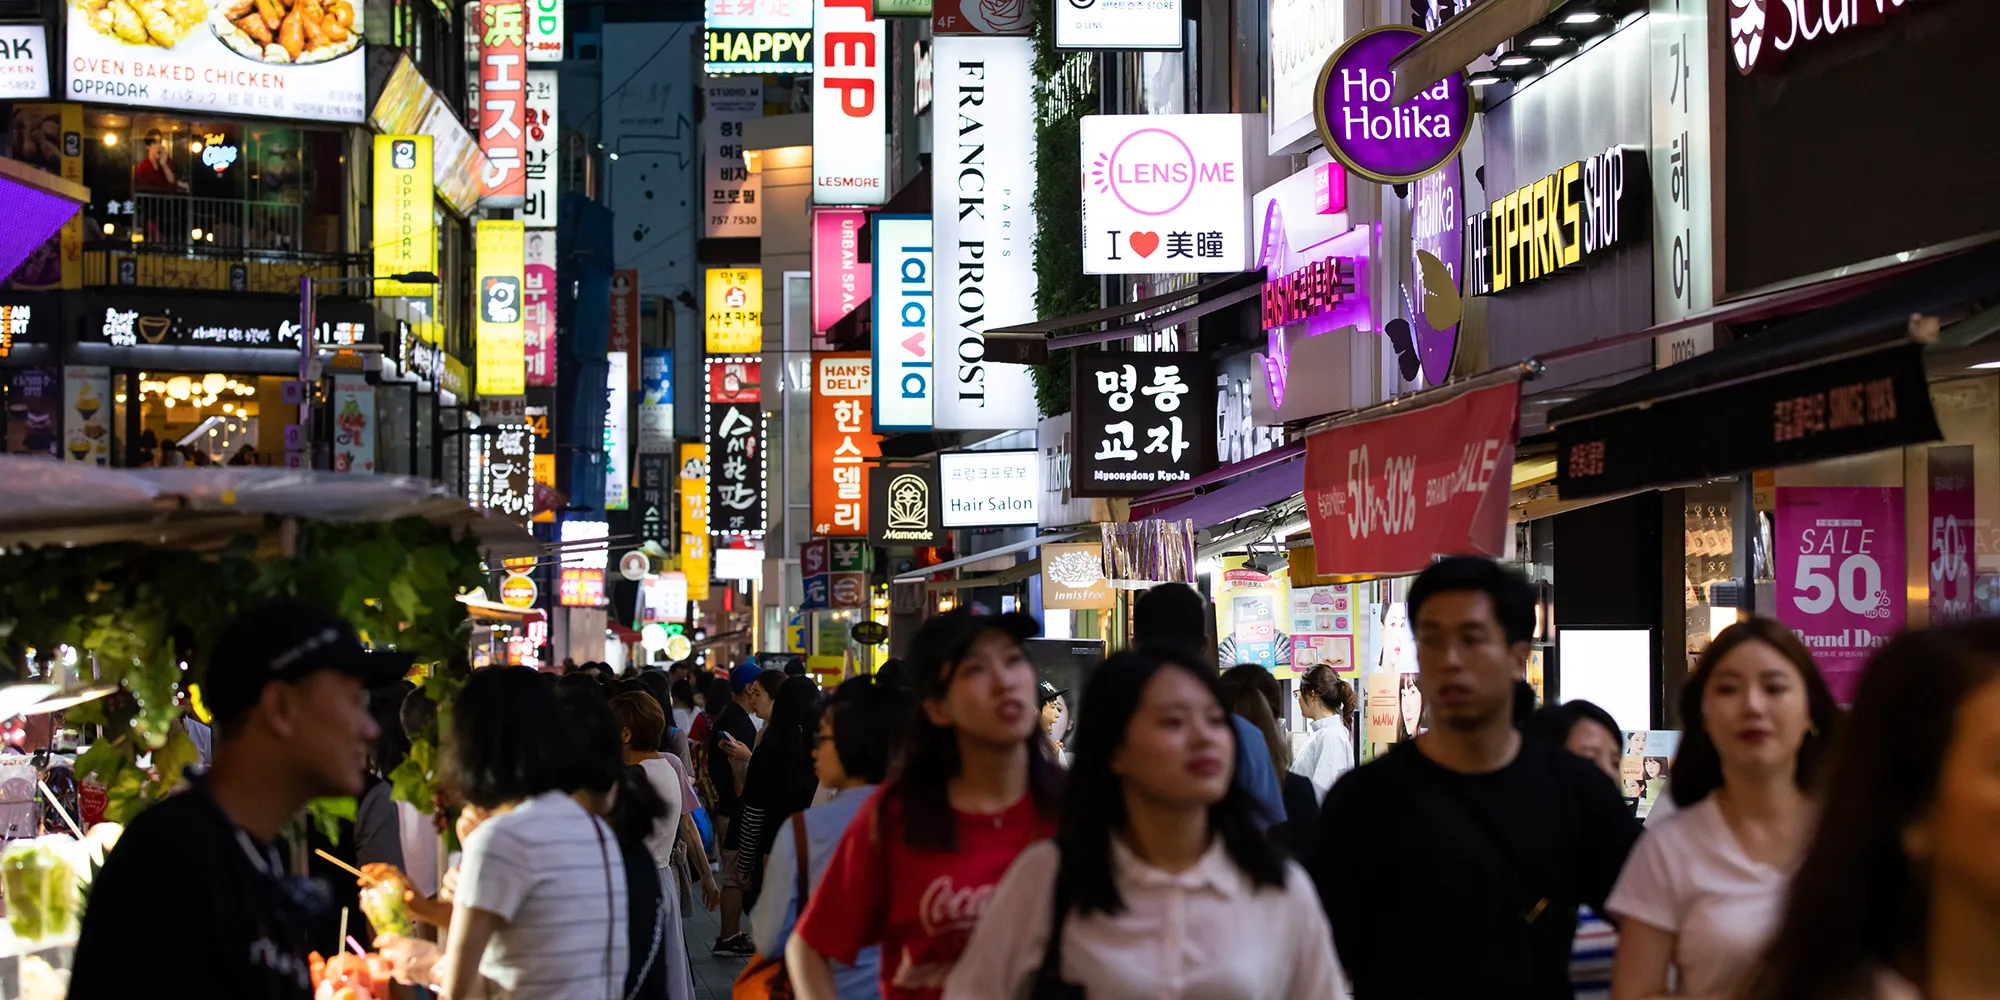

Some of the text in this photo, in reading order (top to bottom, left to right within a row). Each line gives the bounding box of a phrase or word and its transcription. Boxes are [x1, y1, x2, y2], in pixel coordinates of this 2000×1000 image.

[937, 16, 956, 28] 4F
[709, 31, 811, 62] HAPPY
[73, 57, 285, 89] OVEN BAKED CHICKEN
[73, 78, 149, 98] OPPADAK
[1340, 68, 1450, 103] Hoa
[1342, 105, 1451, 140] Holika
[1669, 0, 1692, 309] 가헤어
[818, 176, 880, 188] LESMORE
[1118, 162, 1235, 183] LENS ME
[712, 189, 756, 205] 프로필
[402, 174, 412, 260] OPPADAK
[1001, 188, 1011, 258] PARIS
[1467, 210, 1489, 297] THE
[1583, 143, 1624, 254] SHOP
[958, 59, 985, 408] FRANCK PROVOST
[1107, 230, 1225, 261] I 美瞳
[841, 219, 855, 314] URBAN SPAC
[825, 365, 870, 377] HAN'S
[1095, 364, 1189, 412] 명동
[1094, 416, 1190, 463] 교자
[832, 399, 864, 531] 한스델리
[1094, 470, 1155, 481] Myeongdong
[950, 495, 1033, 513] Hair Salon
[729, 516, 746, 528] 2F
[816, 523, 831, 535] 4F
[883, 528, 934, 541] Mamonde
[1799, 529, 1875, 554] SALE
[1055, 590, 1106, 601] innisfree
